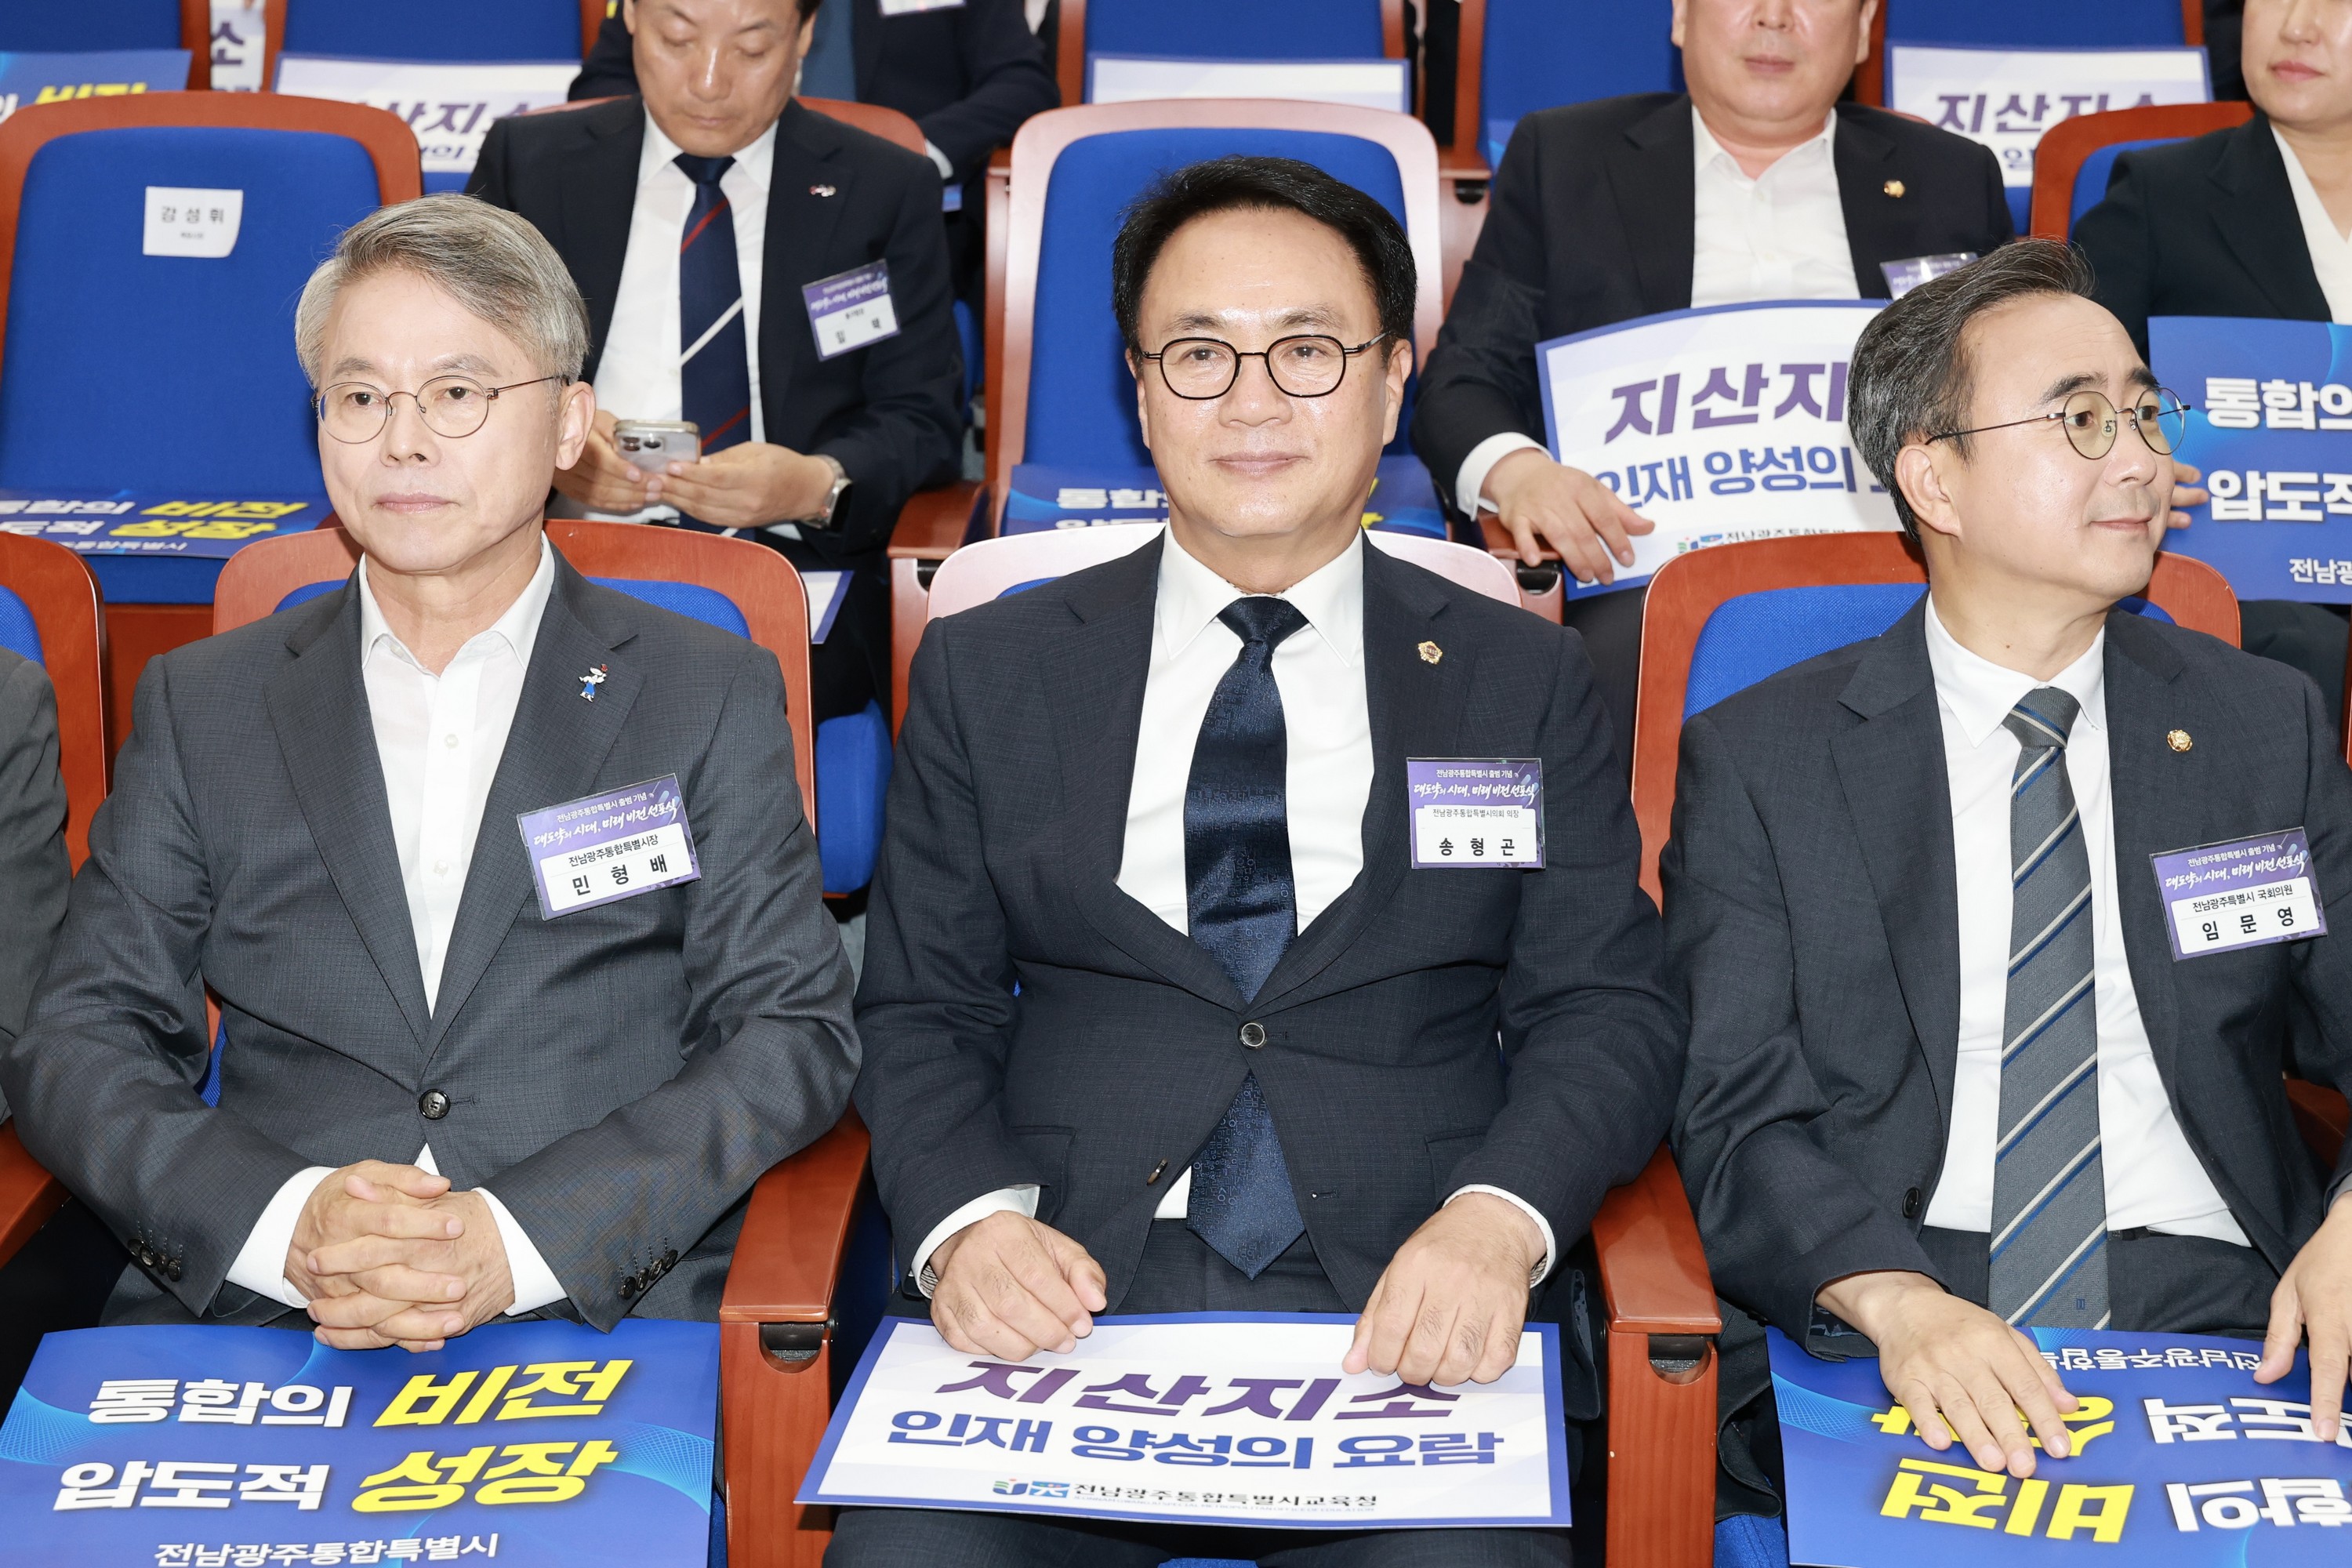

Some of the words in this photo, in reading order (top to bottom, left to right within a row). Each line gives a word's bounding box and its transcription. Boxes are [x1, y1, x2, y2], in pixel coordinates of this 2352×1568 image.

[1937, 93, 2154, 133] 지산지
[1704, 446, 1857, 495] 양성의
[1436, 769, 1488, 779] 전남광주통합특별시
[557, 799, 618, 823] 전남광주통합특별시
[1432, 808, 1504, 818] 전남광주통합특별시의회
[1506, 808, 1519, 818] 의장
[568, 833, 659, 867] 전남광주통합특별시장
[2187, 849, 2248, 867] 전남광주통합특별시
[2193, 891, 2255, 913] 전남광주특별시
[2257, 884, 2294, 900] 국회의원
[89, 1378, 353, 1428] 통합의
[373, 1359, 633, 1427] 비전
[935, 1361, 1461, 1421] 지산지소
[887, 1410, 1052, 1454] 인재
[1071, 1425, 1312, 1469] 양성의
[1333, 1432, 1504, 1468] 요람
[53, 1461, 330, 1511] 압도적
[351, 1440, 618, 1512] 성장
[1074, 1483, 1377, 1507] 전남광주통합특별시교육청
[1881, 1457, 2135, 1543] 비전
[154, 1533, 499, 1568] 전남광주통합특별시
